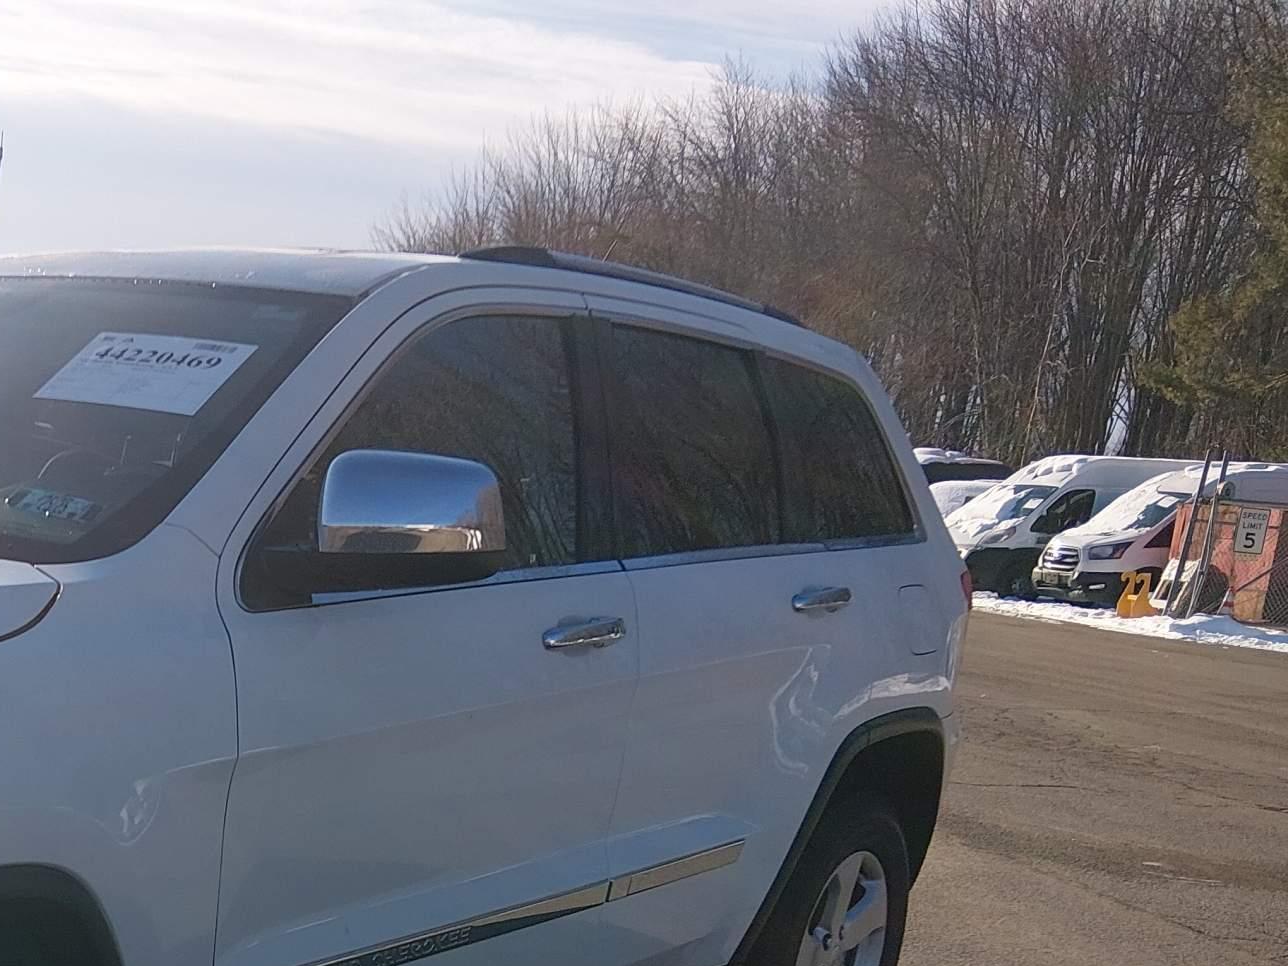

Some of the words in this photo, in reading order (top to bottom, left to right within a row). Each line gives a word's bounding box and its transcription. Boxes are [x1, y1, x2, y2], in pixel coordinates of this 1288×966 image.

[95, 346, 222, 369] 44220469
[1242, 511, 1268, 520] SPEED
[1242, 522, 1263, 530] LIMIT
[1243, 532, 1256, 548] 5
